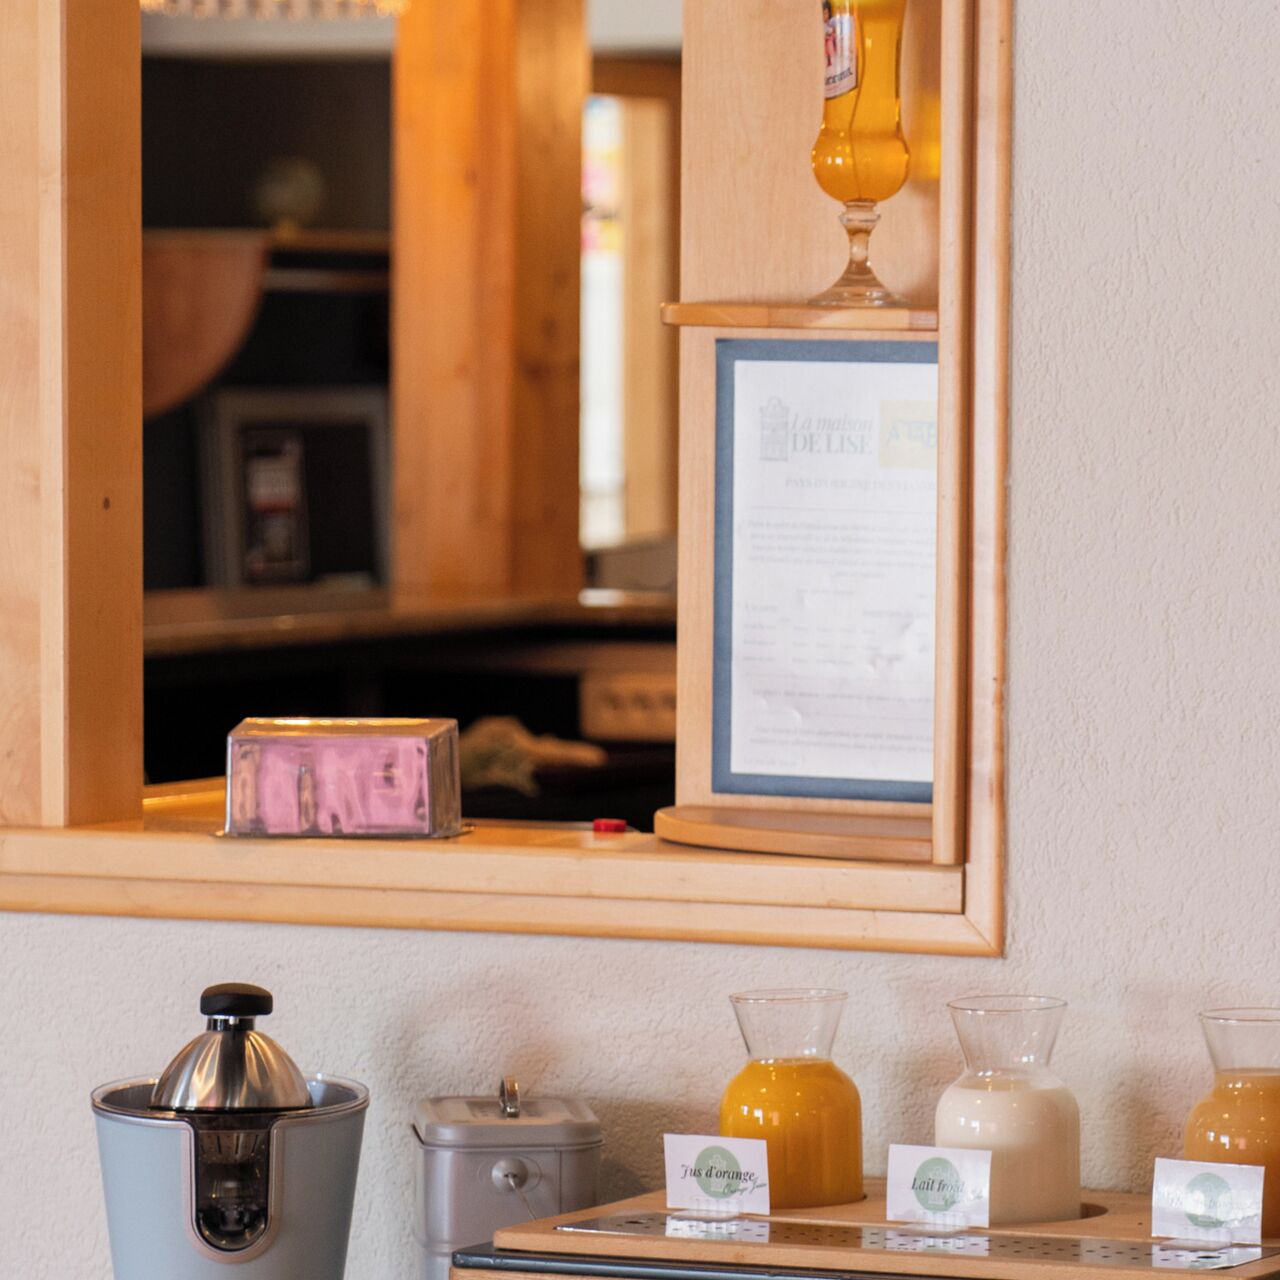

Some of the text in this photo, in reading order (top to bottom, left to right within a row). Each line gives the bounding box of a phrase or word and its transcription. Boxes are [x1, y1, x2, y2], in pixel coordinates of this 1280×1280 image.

[680, 1164, 756, 1184] Jus d'orange
[911, 1176, 936, 1192] Lait
